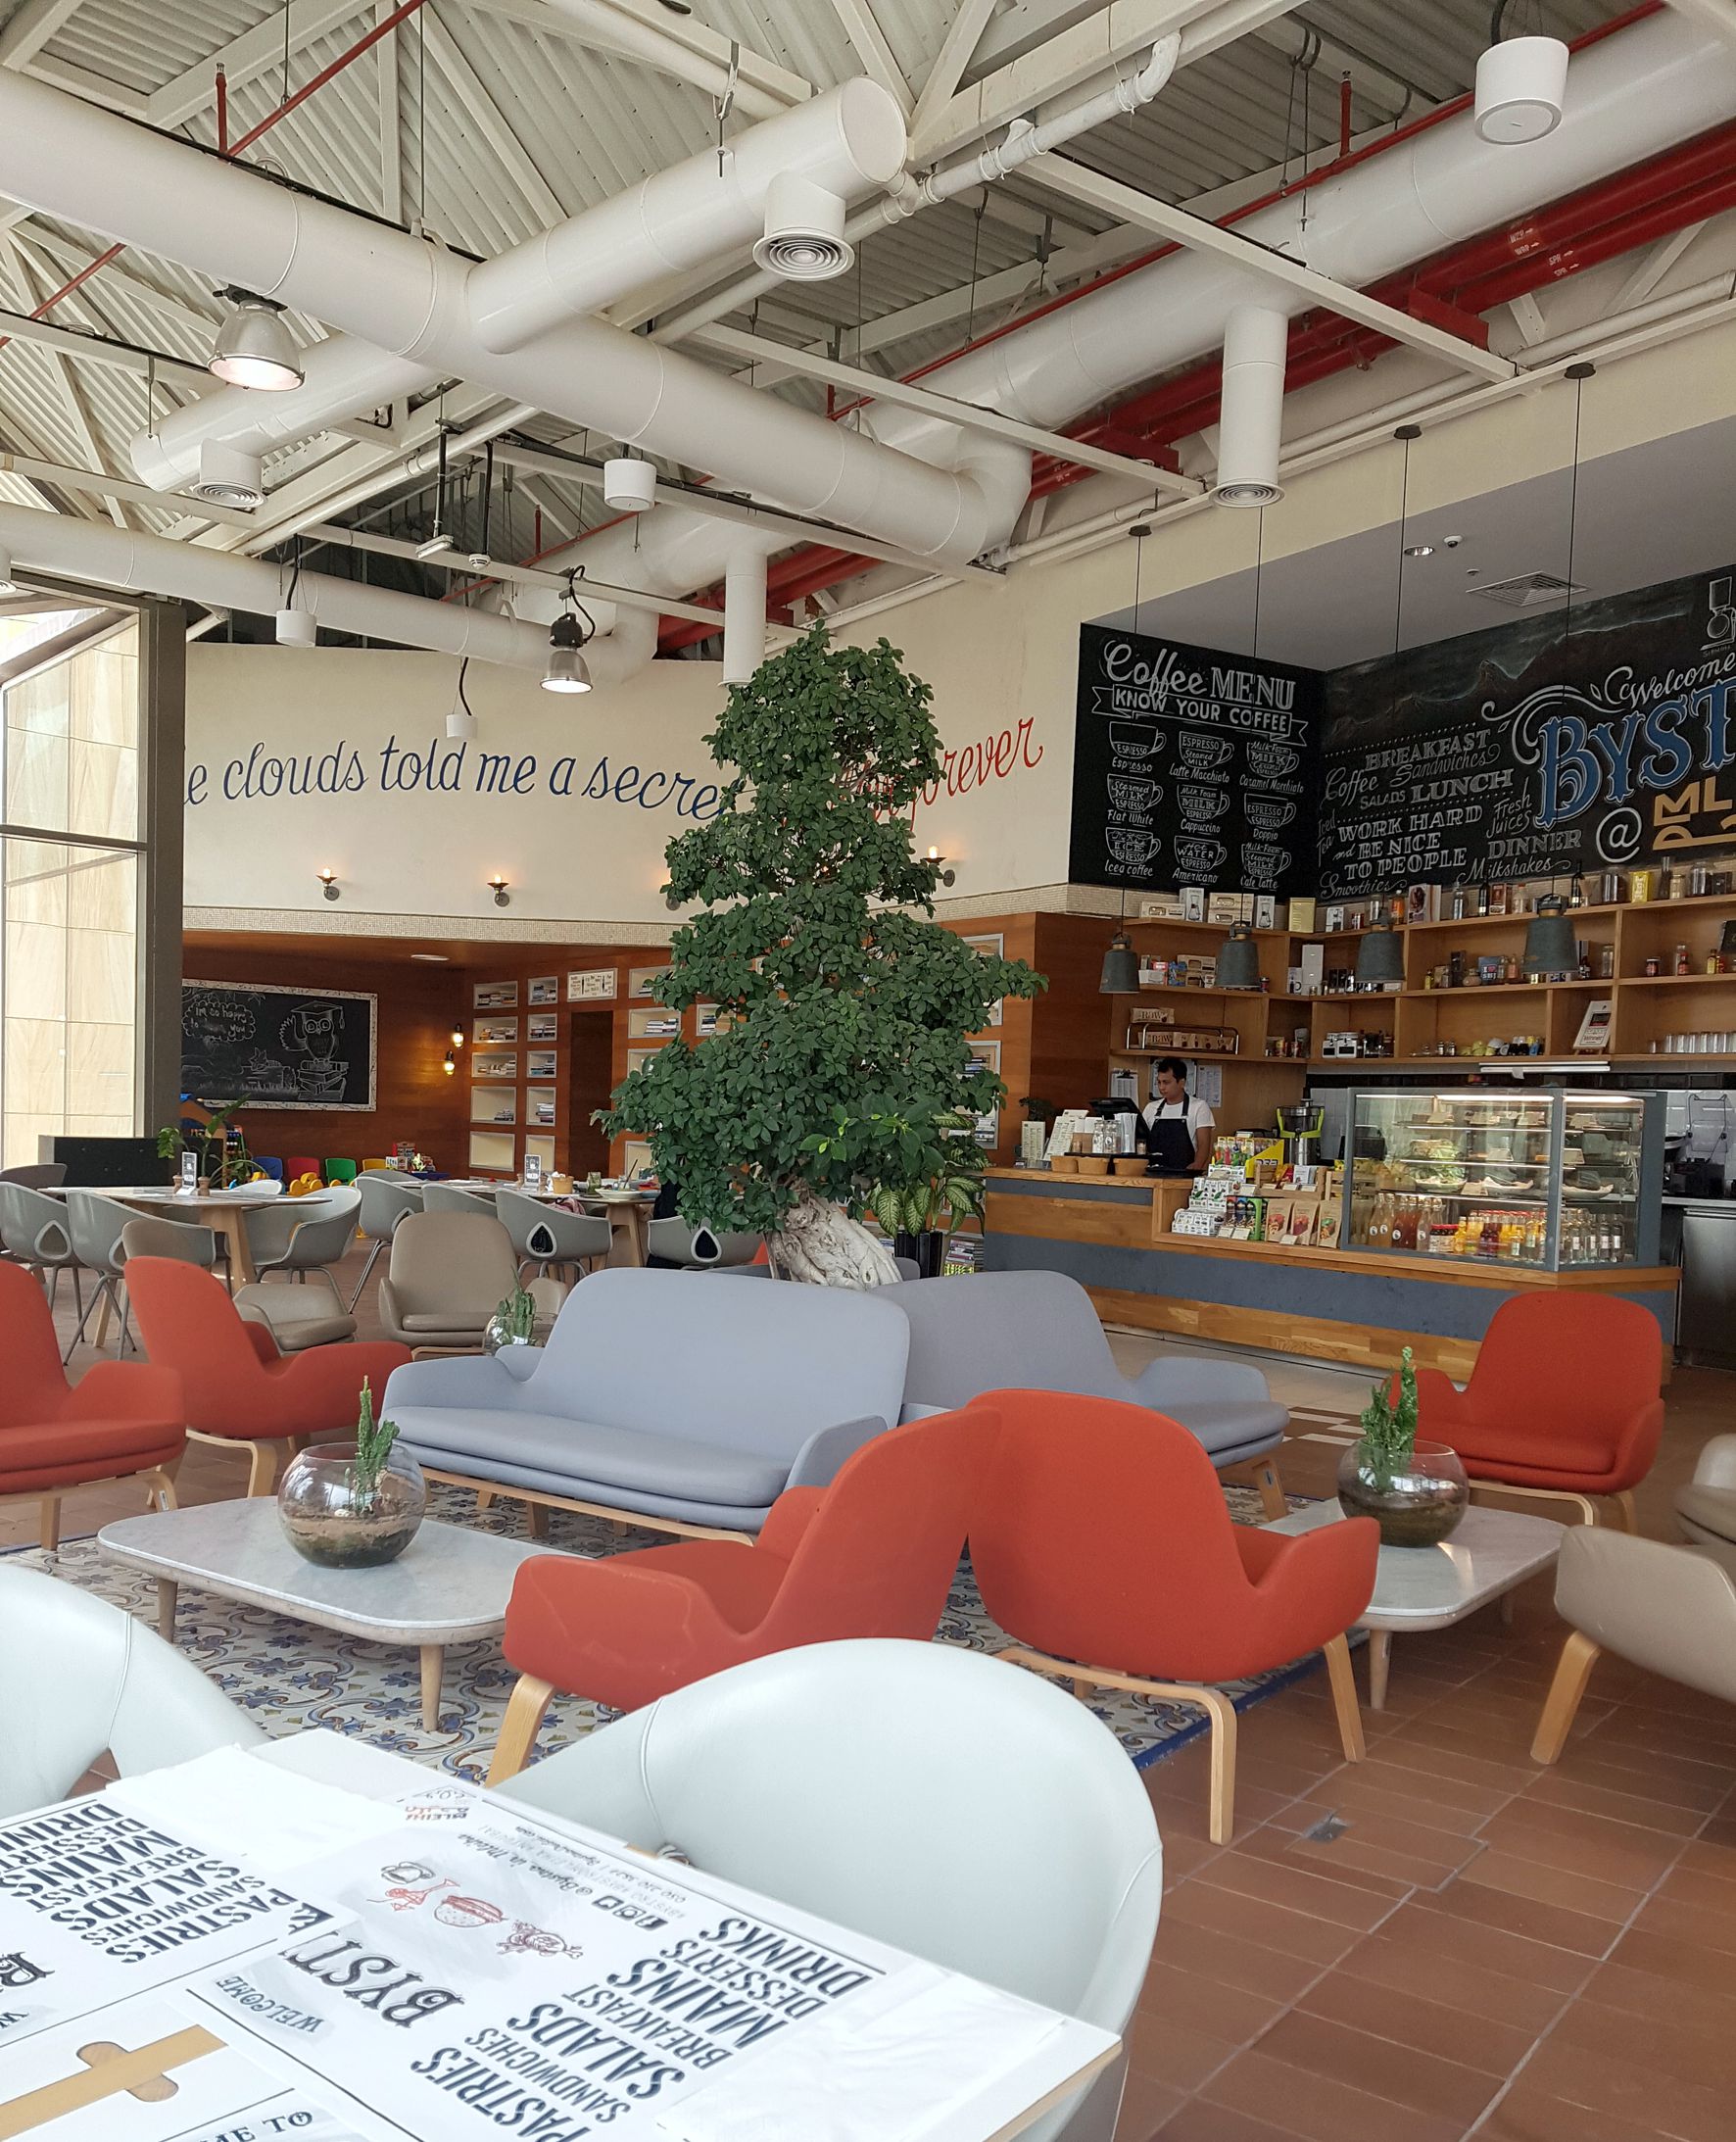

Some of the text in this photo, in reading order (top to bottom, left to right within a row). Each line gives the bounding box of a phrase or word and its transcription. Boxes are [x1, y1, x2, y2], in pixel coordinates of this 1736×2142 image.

[1104, 640, 1296, 710] Coffee MENU
[1605, 653, 1736, 706] Welcome
[1115, 688, 1288, 733] KNOW YOUR COFFEE
[1117, 743, 1148, 756] ESPRESSO
[1181, 736, 1220, 751] ESPRESSO
[1183, 749, 1214, 760] Steamed
[1365, 729, 1491, 772] BREAKFAST
[1112, 756, 1152, 772] Espresso
[1169, 762, 1230, 783] Latte Macchiato
[1187, 758, 1209, 767] MILK
[1251, 751, 1286, 766] MILK
[223, 740, 369, 801] clouds
[379, 734, 467, 793] told
[476, 749, 538, 795] me
[549, 754, 580, 796] a
[581, 756, 727, 821] secre
[1239, 774, 1269, 789] Caramel
[1321, 744, 1501, 807] Coffee Sandwiches
[1410, 768, 1515, 803] LUNCH
[1115, 790, 1144, 802] MILK
[1115, 799, 1145, 811] ESPRESSO
[1181, 798, 1217, 810] MILK
[1247, 804, 1282, 816] ESPRESSO
[1360, 790, 1406, 809] SALADS
[1493, 776, 1533, 820] Fresh
[1107, 809, 1154, 826] Flat White
[1181, 818, 1221, 834] Cappuccino
[1185, 809, 1213, 820] ESPRESSO
[1251, 816, 1281, 828] ESPRESSO
[1337, 804, 1483, 843] WORK HARD
[1486, 809, 1532, 839] Juices
[1253, 828, 1278, 841] Doppio
[1358, 840, 1384, 860] BE
[1387, 832, 1442, 856] NICE
[1487, 829, 1583, 860] DINNER
[1115, 851, 1145, 863] ESPRESSO
[1177, 847, 1214, 859] WATER
[1181, 857, 1211, 869] ESPRESSO
[1343, 847, 1468, 881] TO PEOPLE
[1127, 864, 1154, 877] coffee
[1173, 866, 1219, 884] Americano
[1458, 856, 1570, 885] Milkshakes
[1320, 871, 1407, 900] Smoothies
[0, 1818, 149, 1872] DESSERT
[0, 1830, 183, 1898] MAINS
[25, 1846, 208, 1913] BREAKFAST
[51, 1860, 241, 1930] SALADS
[80, 1875, 265, 1946] SANDWICHES
[105, 1887, 295, 1964] PASTRIES
[698, 1917, 875, 2001] DRINKS
[279, 1930, 466, 2028] BYST
[659, 1938, 830, 2021] DESSERTS
[216, 1974, 326, 2034] WELCOME
[605, 1958, 791, 2051] MAINS
[560, 1982, 736, 2071] BREAKFAST
[506, 2002, 687, 2101] SALADS
[462, 2025, 633, 2124] SANDWICHES
[410, 2047, 593, 2142] PASTRIES
[262, 2110, 313, 2135] TO
